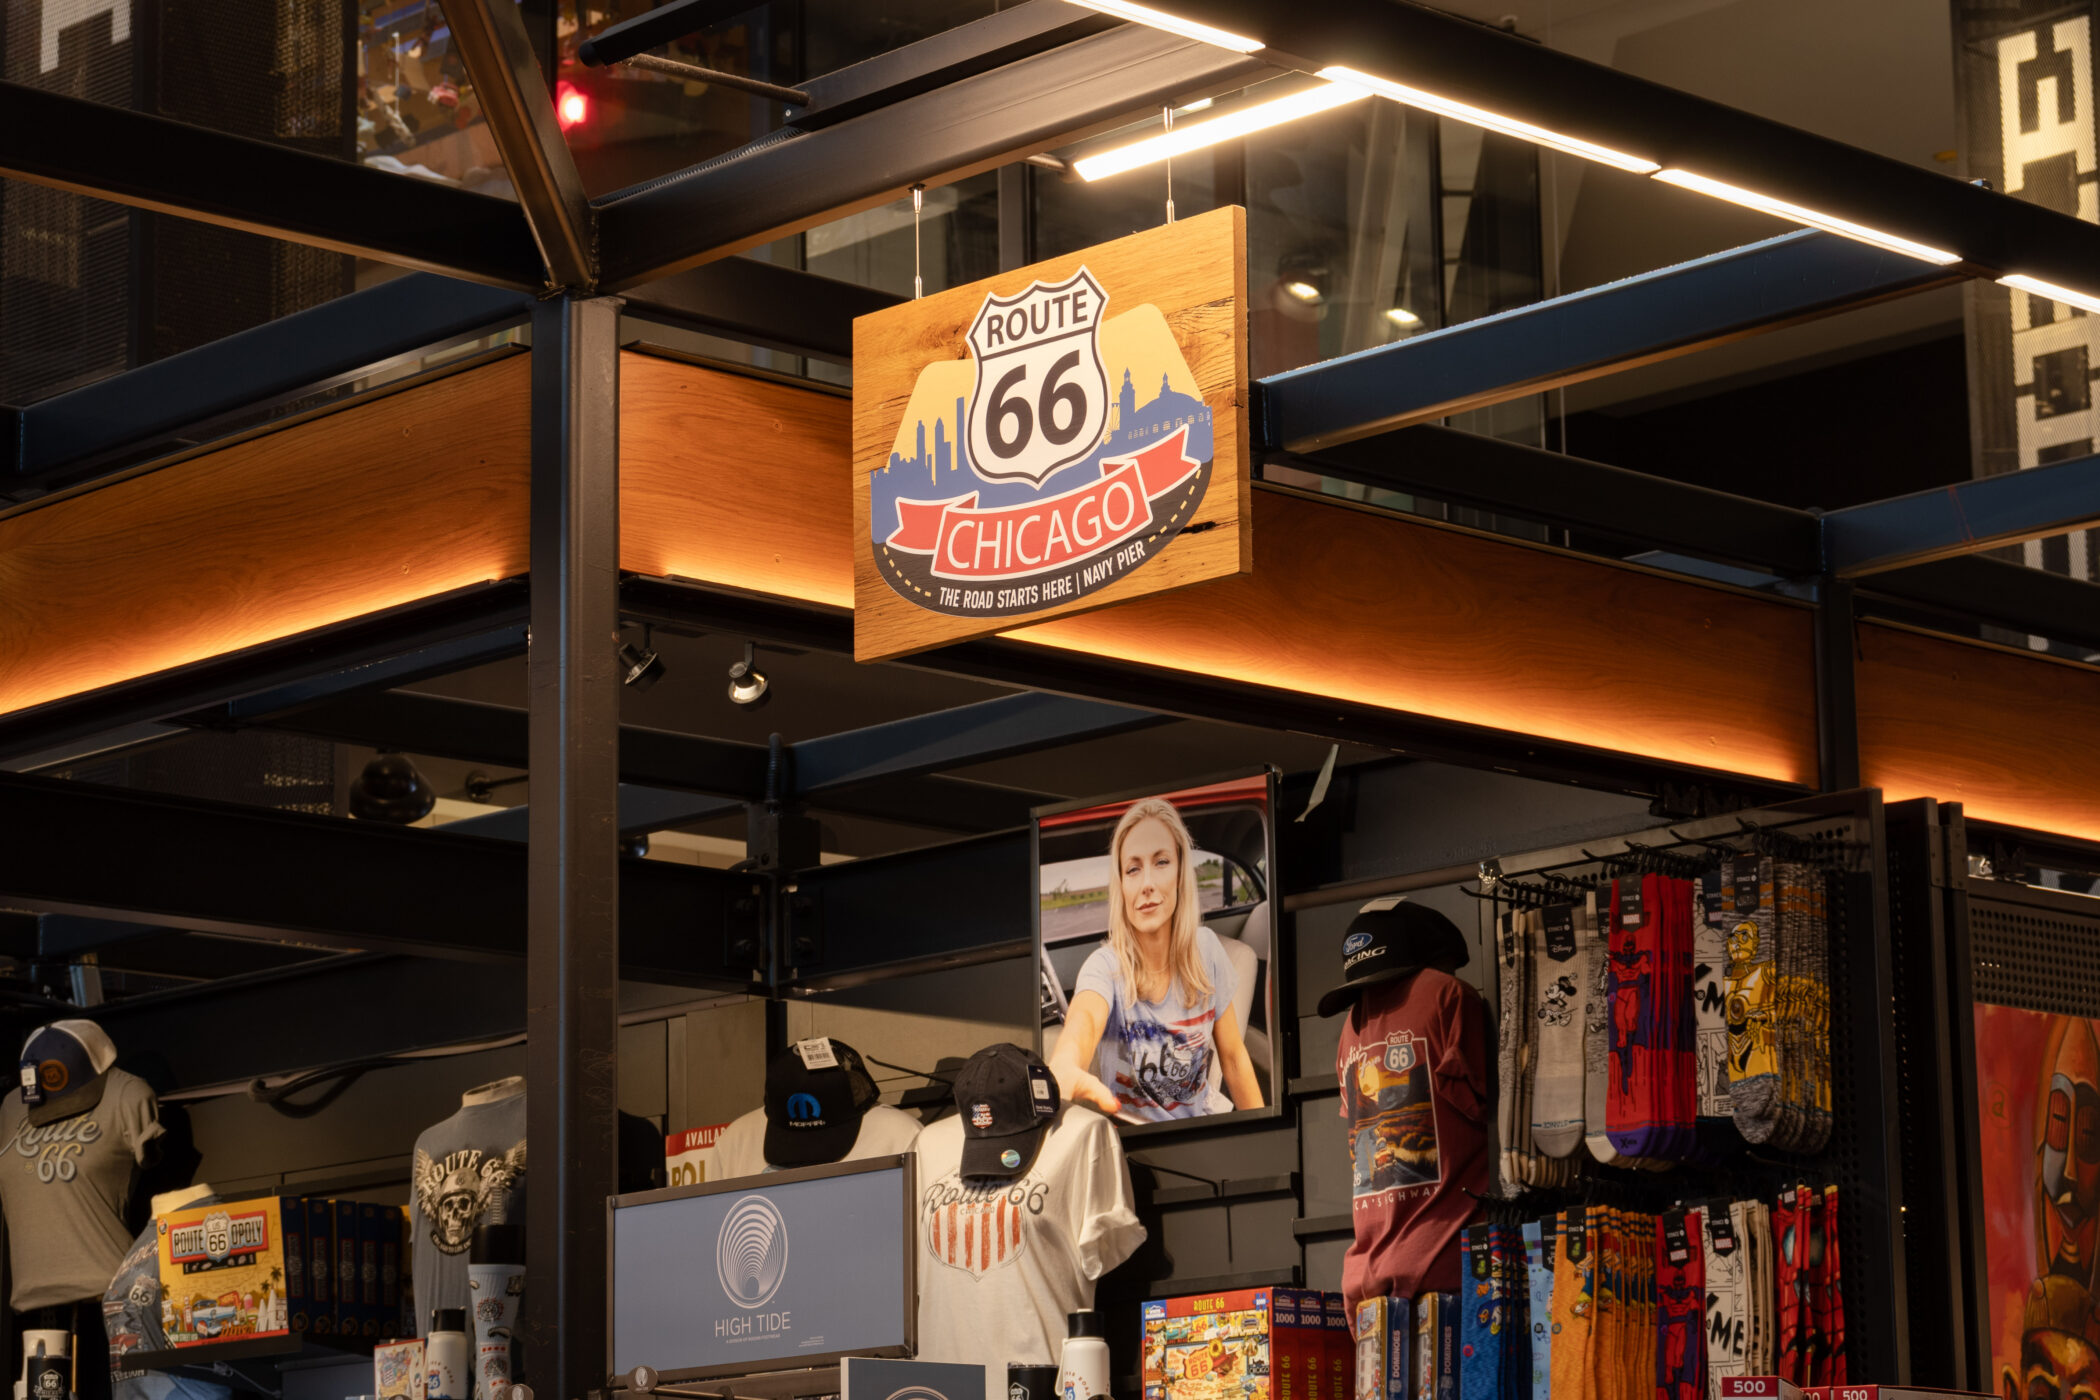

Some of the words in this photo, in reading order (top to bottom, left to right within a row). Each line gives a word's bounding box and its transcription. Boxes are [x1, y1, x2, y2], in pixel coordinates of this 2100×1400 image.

[986, 288, 1089, 349] ROUTE
[985, 349, 1088, 460] 66
[946, 480, 1136, 570] CHICAGO
[939, 585, 962, 607] THE
[963, 588, 995, 610] ROAD
[996, 585, 1039, 609] STARTS
[1042, 577, 1073, 602] HERE
[1083, 561, 1116, 588] NAVY
[1116, 540, 1147, 573] PIER
[1390, 1034, 1409, 1044] ROUTE
[1389, 1047, 1409, 1069] 66
[1171, 1061, 1188, 1077] 66
[37, 1143, 82, 1182] 66
[420, 1149, 482, 1195] ROUTE
[481, 1158, 506, 1186] 66
[1007, 1178, 1050, 1215] 66
[174, 1229, 204, 1254] ROUTE
[208, 1234, 226, 1252] 66
[231, 1220, 263, 1245] OPOLY
[130, 1287, 150, 1304] 66
[1193, 1298, 1214, 1311] ROUTE
[1215, 1296, 1225, 1309] 66
[714, 1315, 752, 1338] HIGH
[756, 1311, 792, 1332] TIDE
[1275, 1313, 1295, 1324] 1000
[1300, 1314, 1321, 1325] 1000
[1326, 1317, 1346, 1328] 1000
[1281, 1355, 1291, 1369] 66
[1392, 1329, 1401, 1379] DOMINOES
[1190, 1360, 1209, 1378] 66
[1307, 1356, 1317, 1370] 66
[45, 1379, 57, 1388] 66
[1733, 1380, 1766, 1394] 500
[1842, 1389, 1868, 1400] 500
